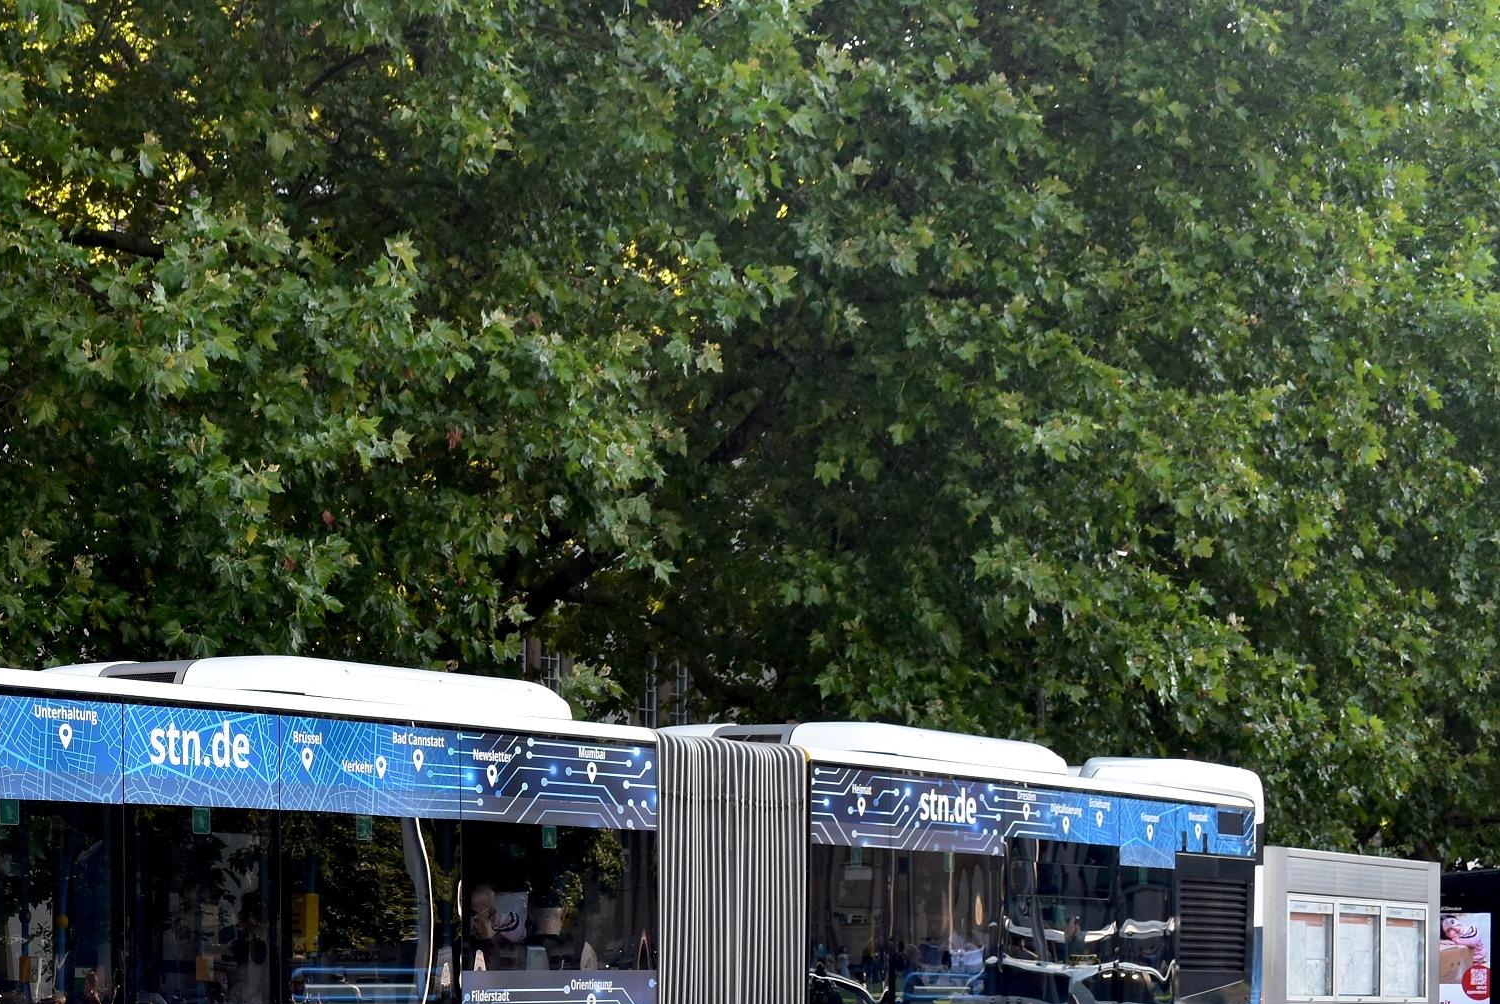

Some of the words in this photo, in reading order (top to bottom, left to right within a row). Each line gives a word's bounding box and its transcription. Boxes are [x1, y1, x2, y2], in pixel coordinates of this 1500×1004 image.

[34, 704, 98, 725] Unterhaltung
[292, 730, 322, 745] Brüssel
[392, 732, 406, 745] Bad
[408, 733, 444, 748] Cannstatt
[150, 721, 249, 769] stn.de
[473, 749, 512, 763] Newsletter
[578, 748, 606, 760] Mumbai
[342, 761, 373, 775] Verkehr
[852, 783, 872, 796] Heimat
[919, 787, 977, 824] stn.de
[570, 979, 613, 993] Orientierung
[471, 990, 510, 1002] Filderstadt
